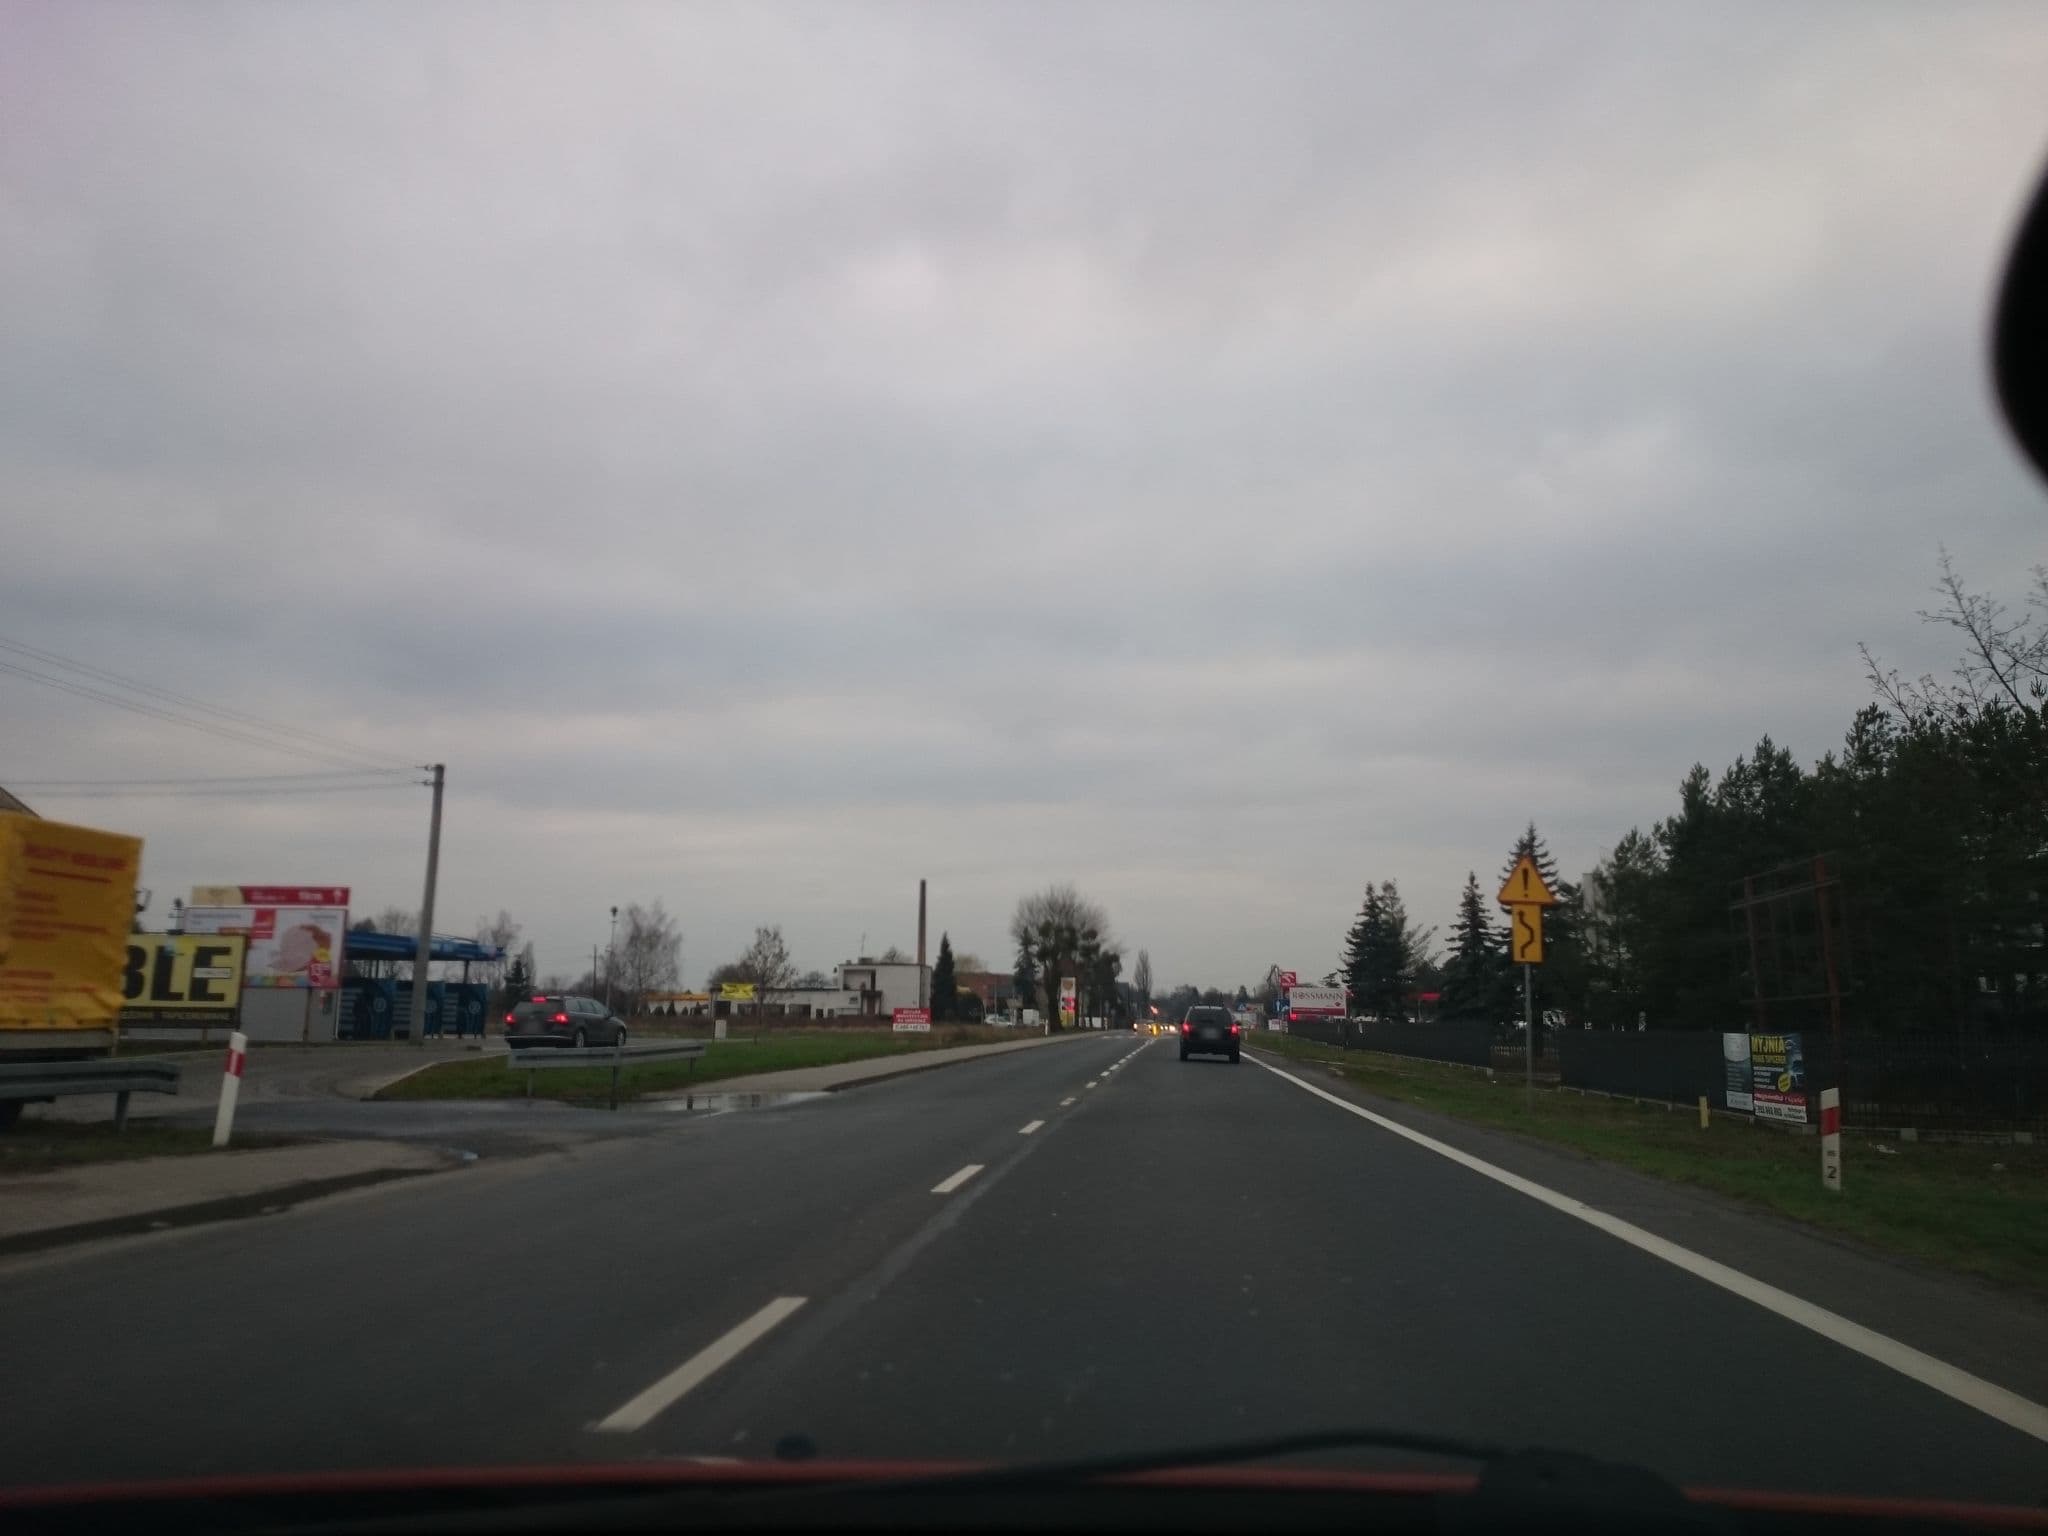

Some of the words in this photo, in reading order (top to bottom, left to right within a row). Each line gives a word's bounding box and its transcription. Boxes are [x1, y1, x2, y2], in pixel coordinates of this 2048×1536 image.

[1292, 991, 1344, 1001] ROSSMANN
[1751, 1035, 1786, 1054] MYJNIA
[1827, 1165, 1837, 1179] 2
